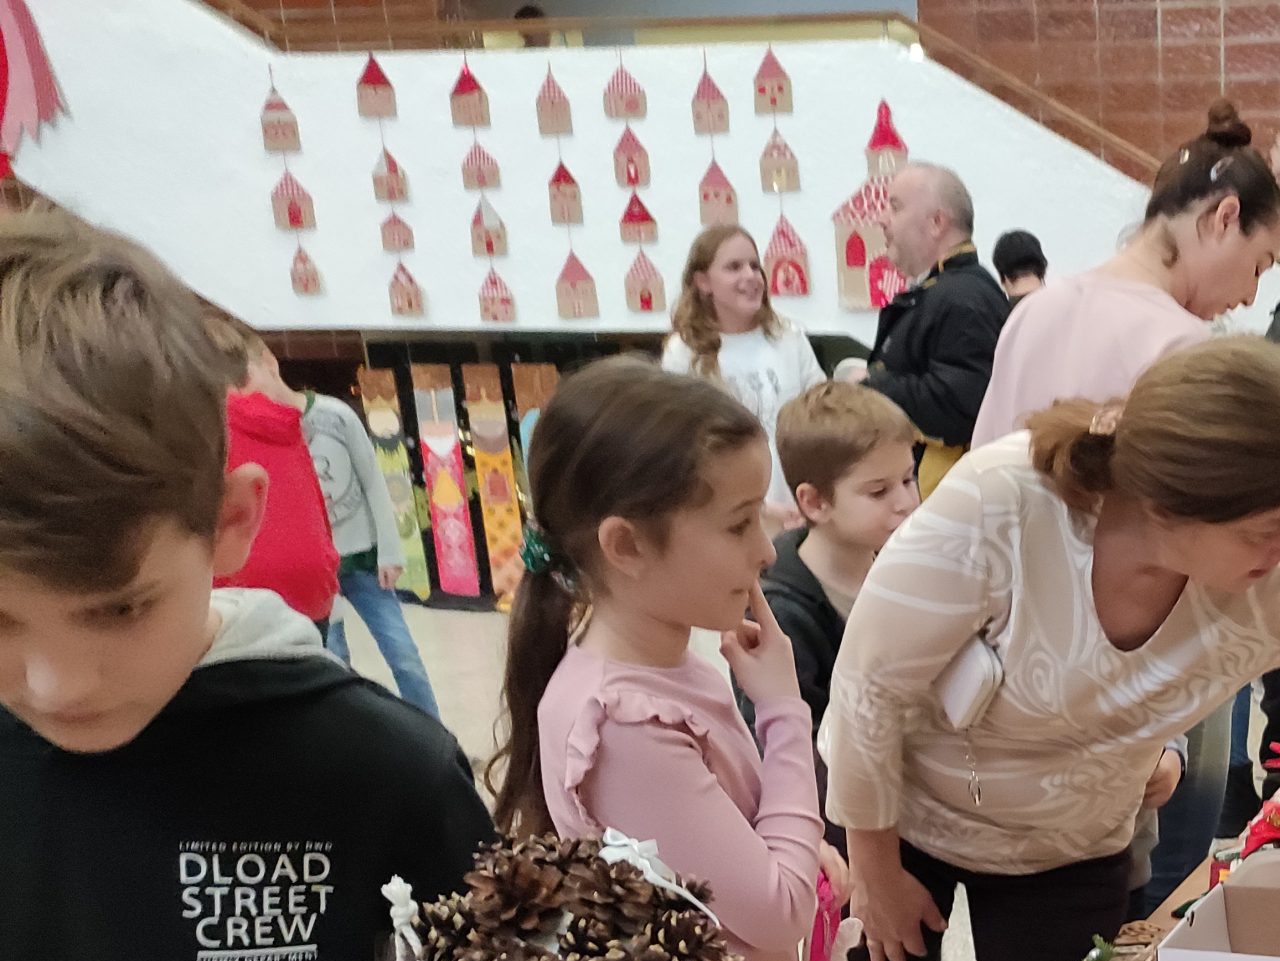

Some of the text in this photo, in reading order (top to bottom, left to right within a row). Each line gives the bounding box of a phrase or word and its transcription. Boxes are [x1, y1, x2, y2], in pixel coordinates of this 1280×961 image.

[179, 852, 331, 885] DLOAD
[182, 884, 335, 919] STREET
[195, 912, 318, 948] CREW
